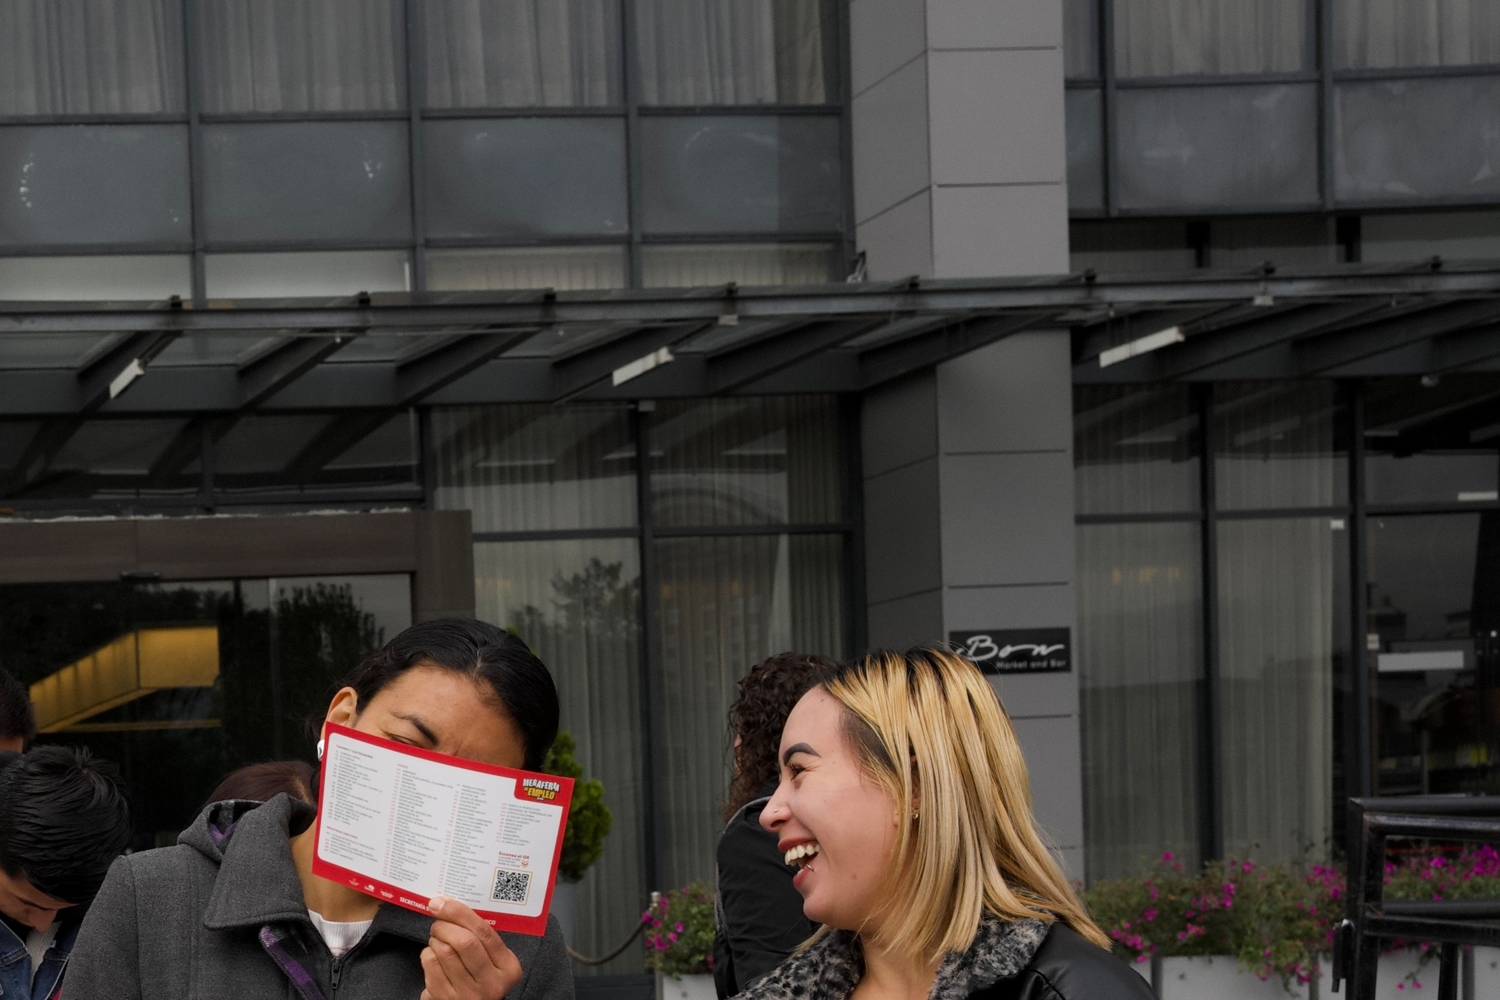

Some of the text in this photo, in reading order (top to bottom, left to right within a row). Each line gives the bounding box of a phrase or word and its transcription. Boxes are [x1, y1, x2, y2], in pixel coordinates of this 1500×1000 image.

[996, 658, 1066, 669] Market and Bar
[527, 787, 555, 800] EMPLEO
